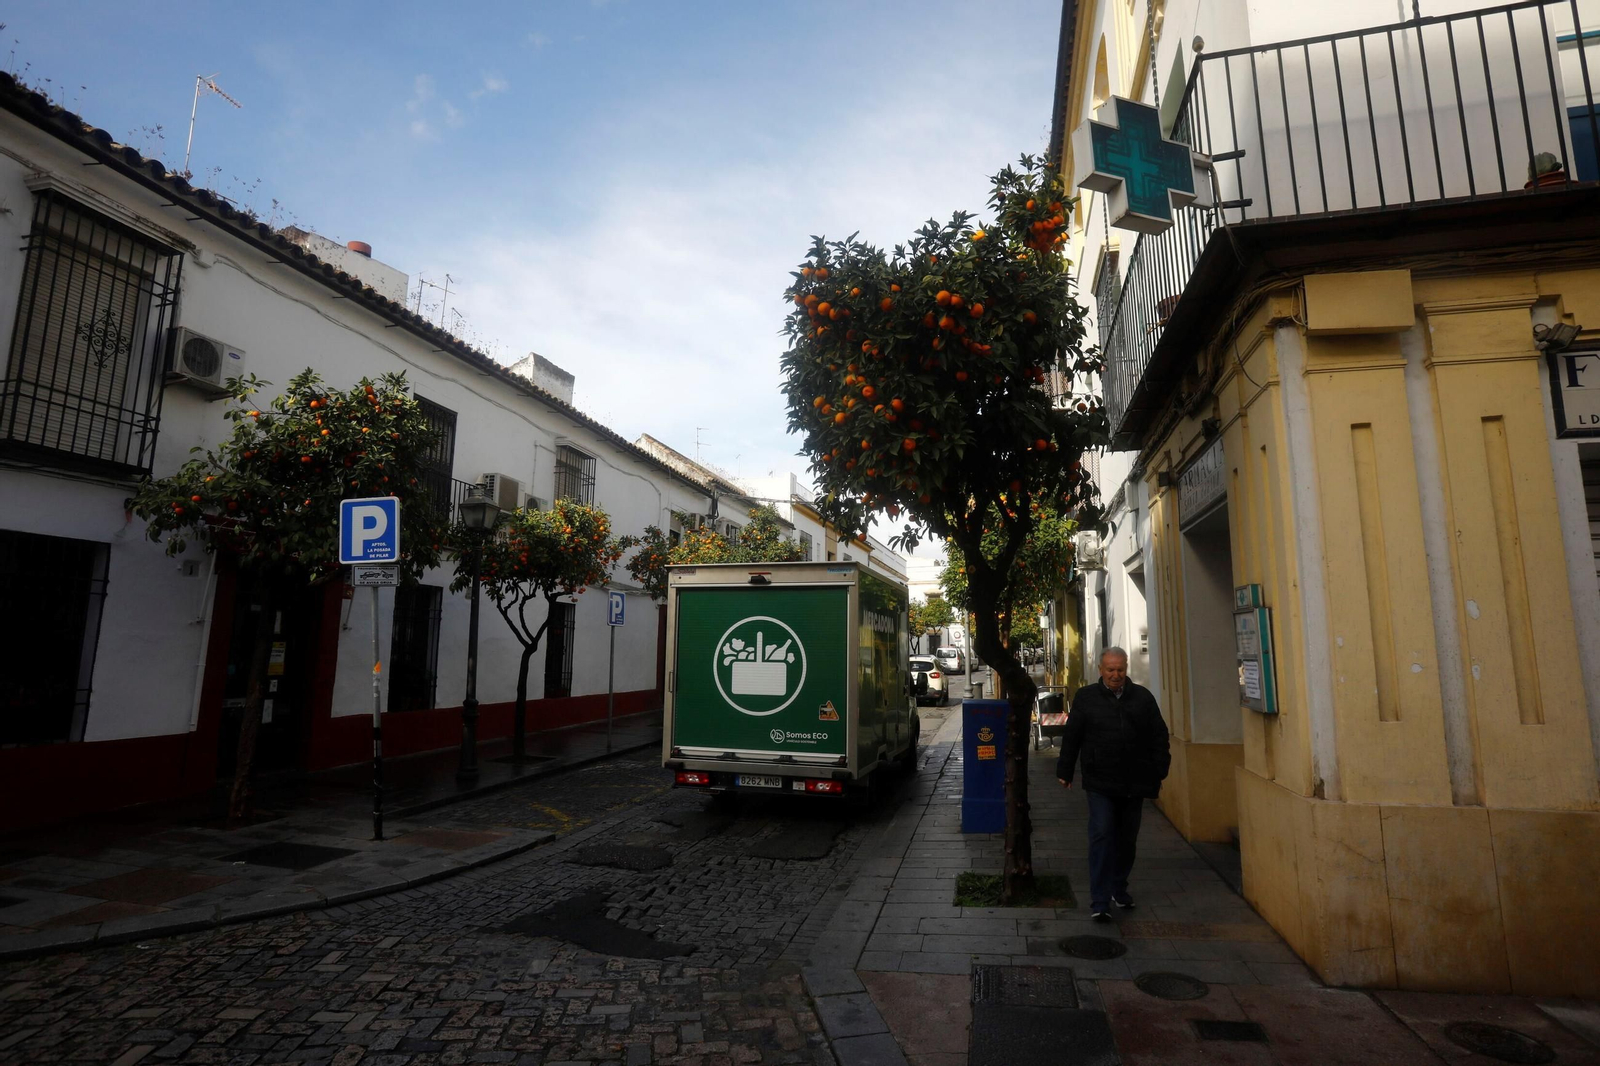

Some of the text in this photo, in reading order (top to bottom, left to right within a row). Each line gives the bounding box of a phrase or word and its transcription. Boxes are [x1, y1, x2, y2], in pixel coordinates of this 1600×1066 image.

[1179, 438, 1225, 500] FARMACIA
[352, 506, 388, 556] P
[612, 595, 622, 622] P
[786, 731, 829, 740] Somos ECO
[740, 776, 780, 787] 8262 MNB
